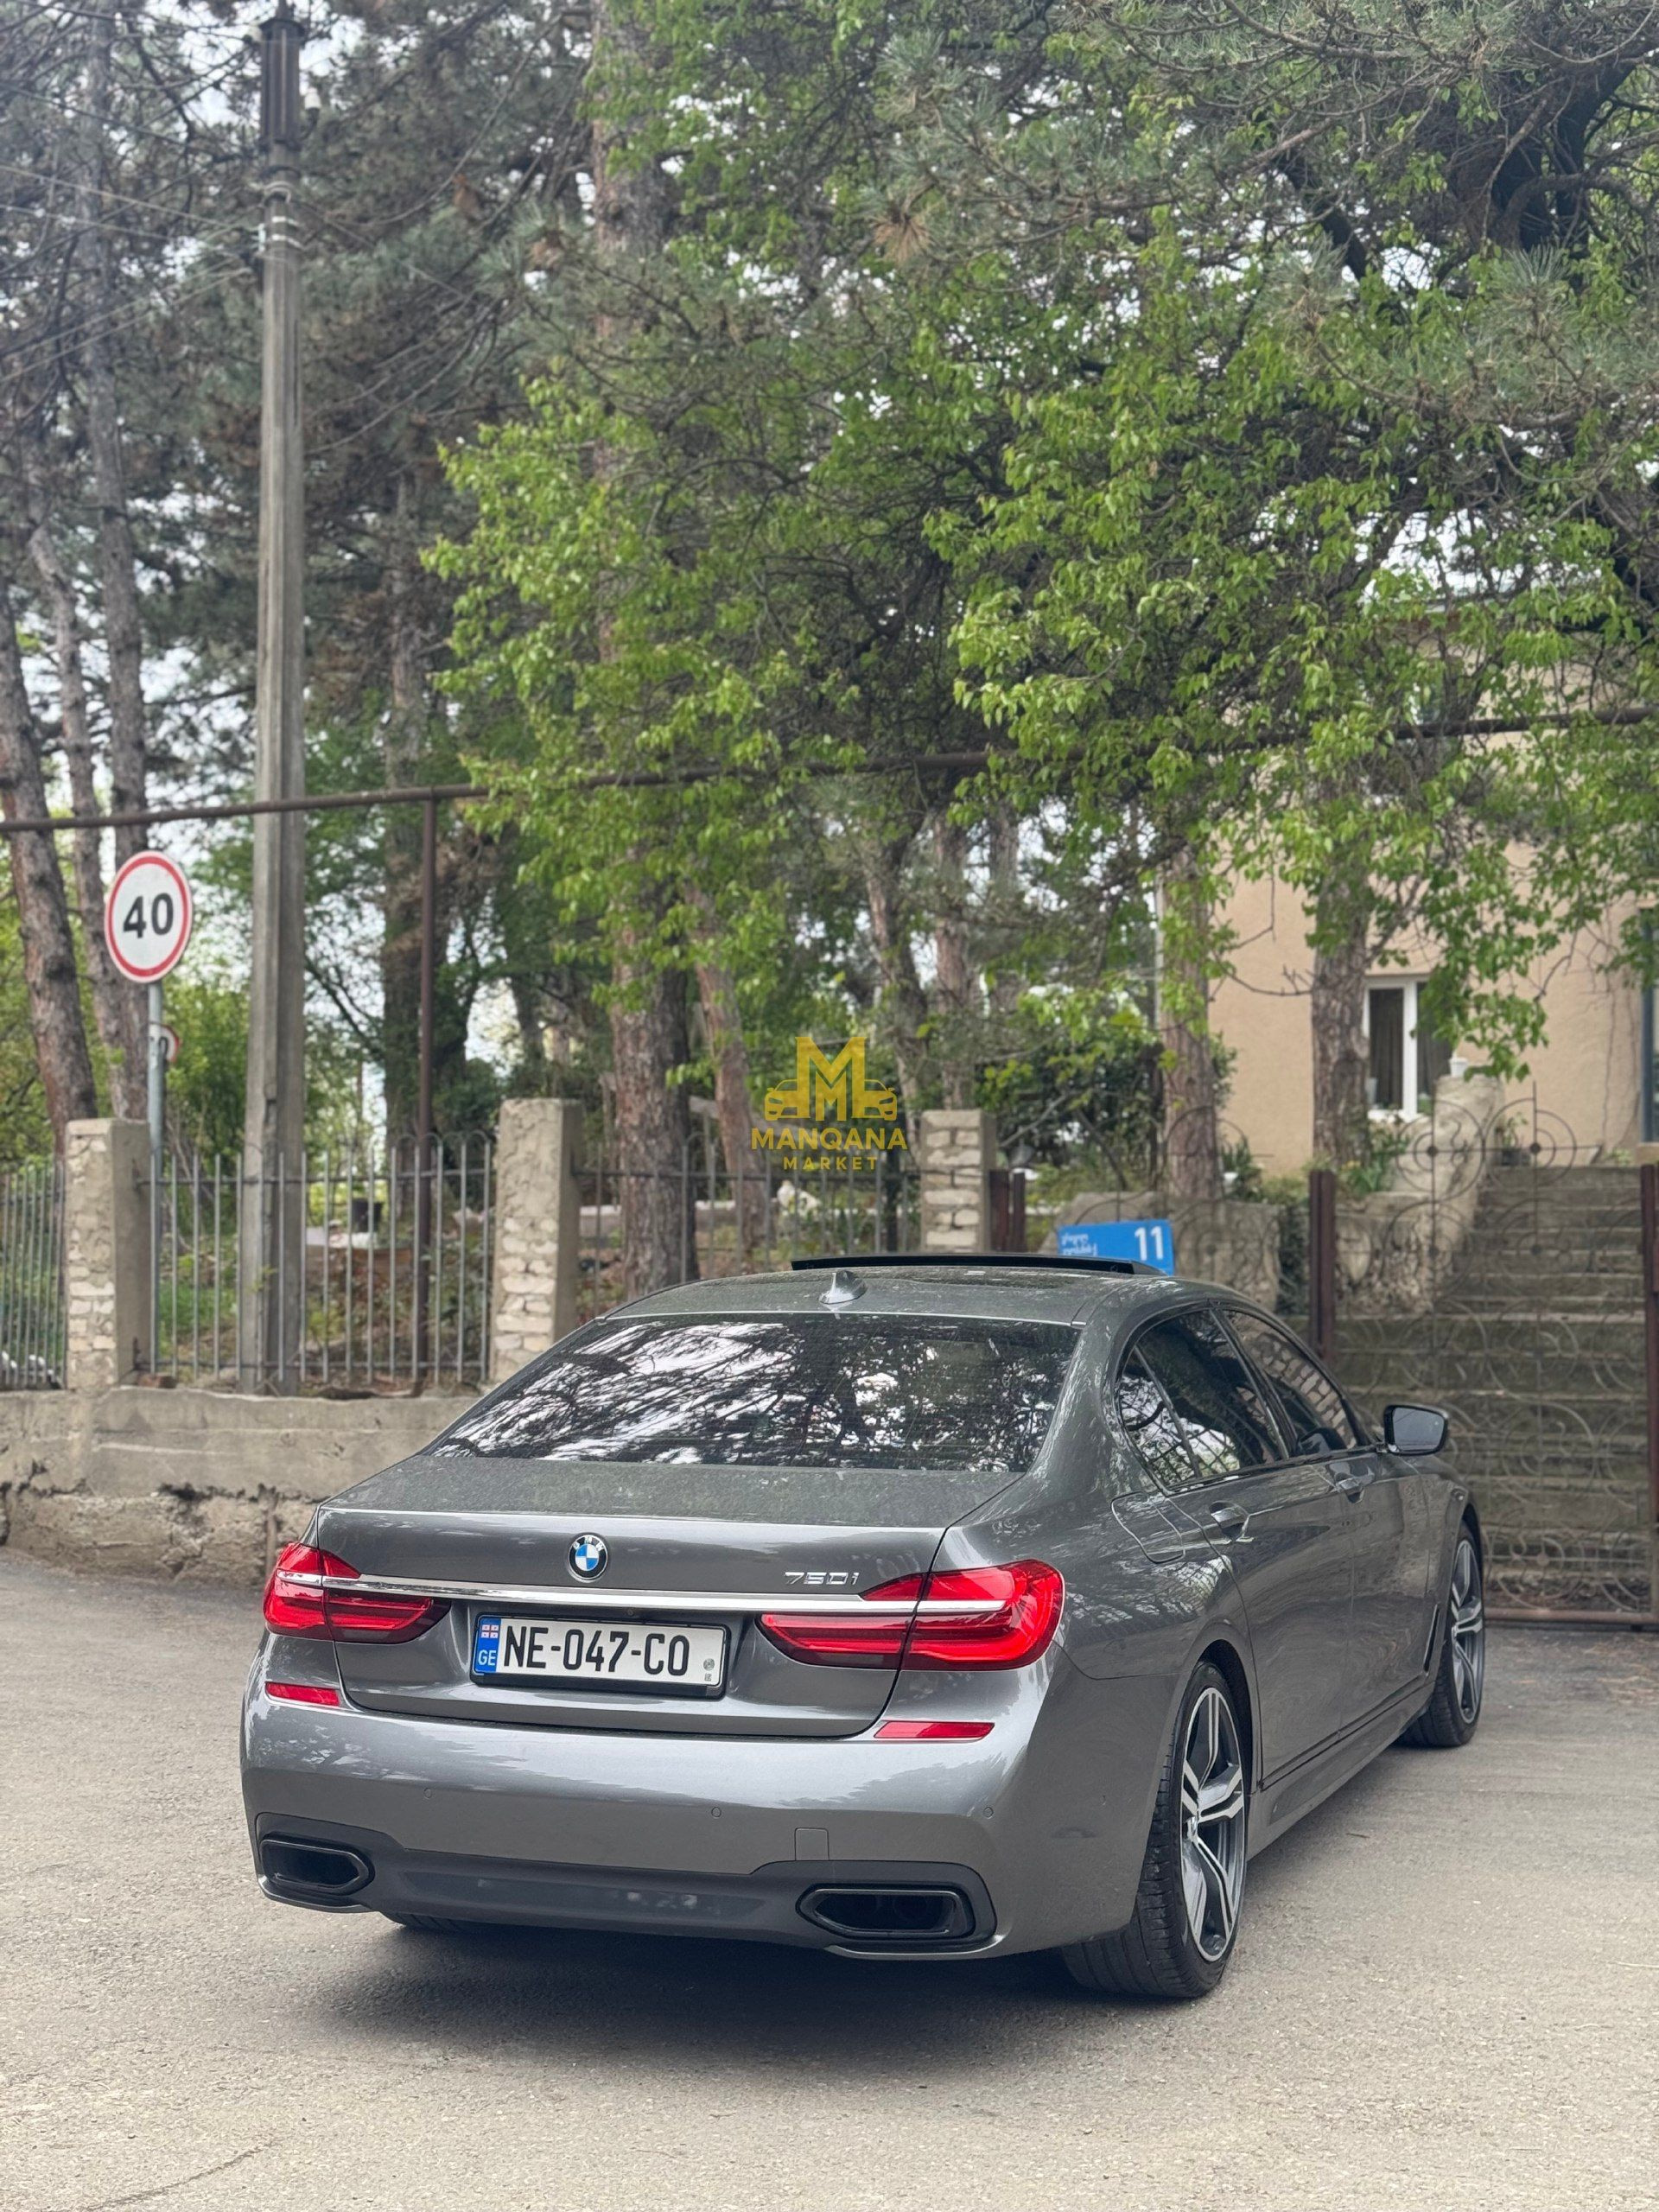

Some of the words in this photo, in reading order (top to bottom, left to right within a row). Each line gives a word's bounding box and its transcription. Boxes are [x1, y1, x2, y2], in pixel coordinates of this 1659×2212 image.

[123, 893, 174, 939] 40
[1135, 1226, 1164, 1261] 11
[784, 1572, 860, 1586] 750i
[478, 1649, 497, 1666] GE
[504, 1624, 690, 1676] NE-047-CO
